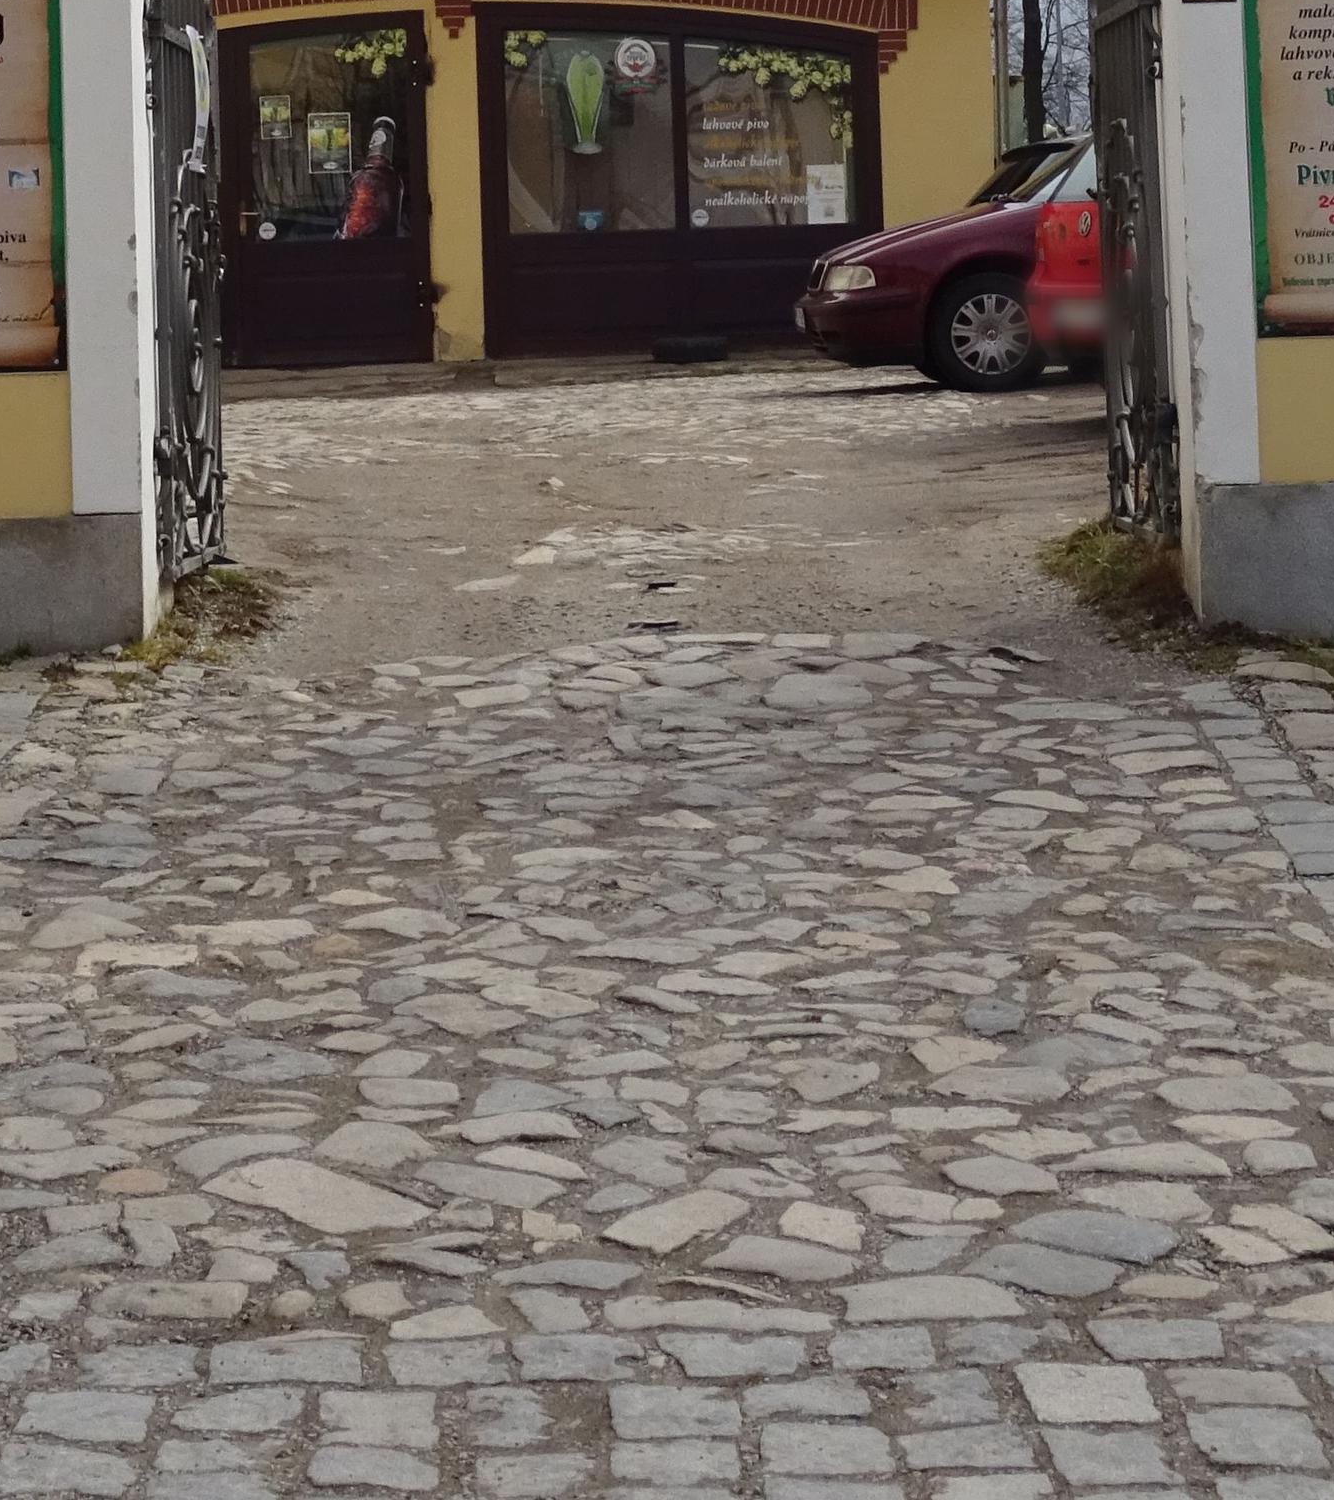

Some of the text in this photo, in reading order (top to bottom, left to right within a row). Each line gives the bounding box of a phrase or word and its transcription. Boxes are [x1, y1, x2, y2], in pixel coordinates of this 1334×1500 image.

[1292, 70, 1303, 81] a
[746, 118, 770, 132] pivo
[1288, 141, 1306, 154] Po
